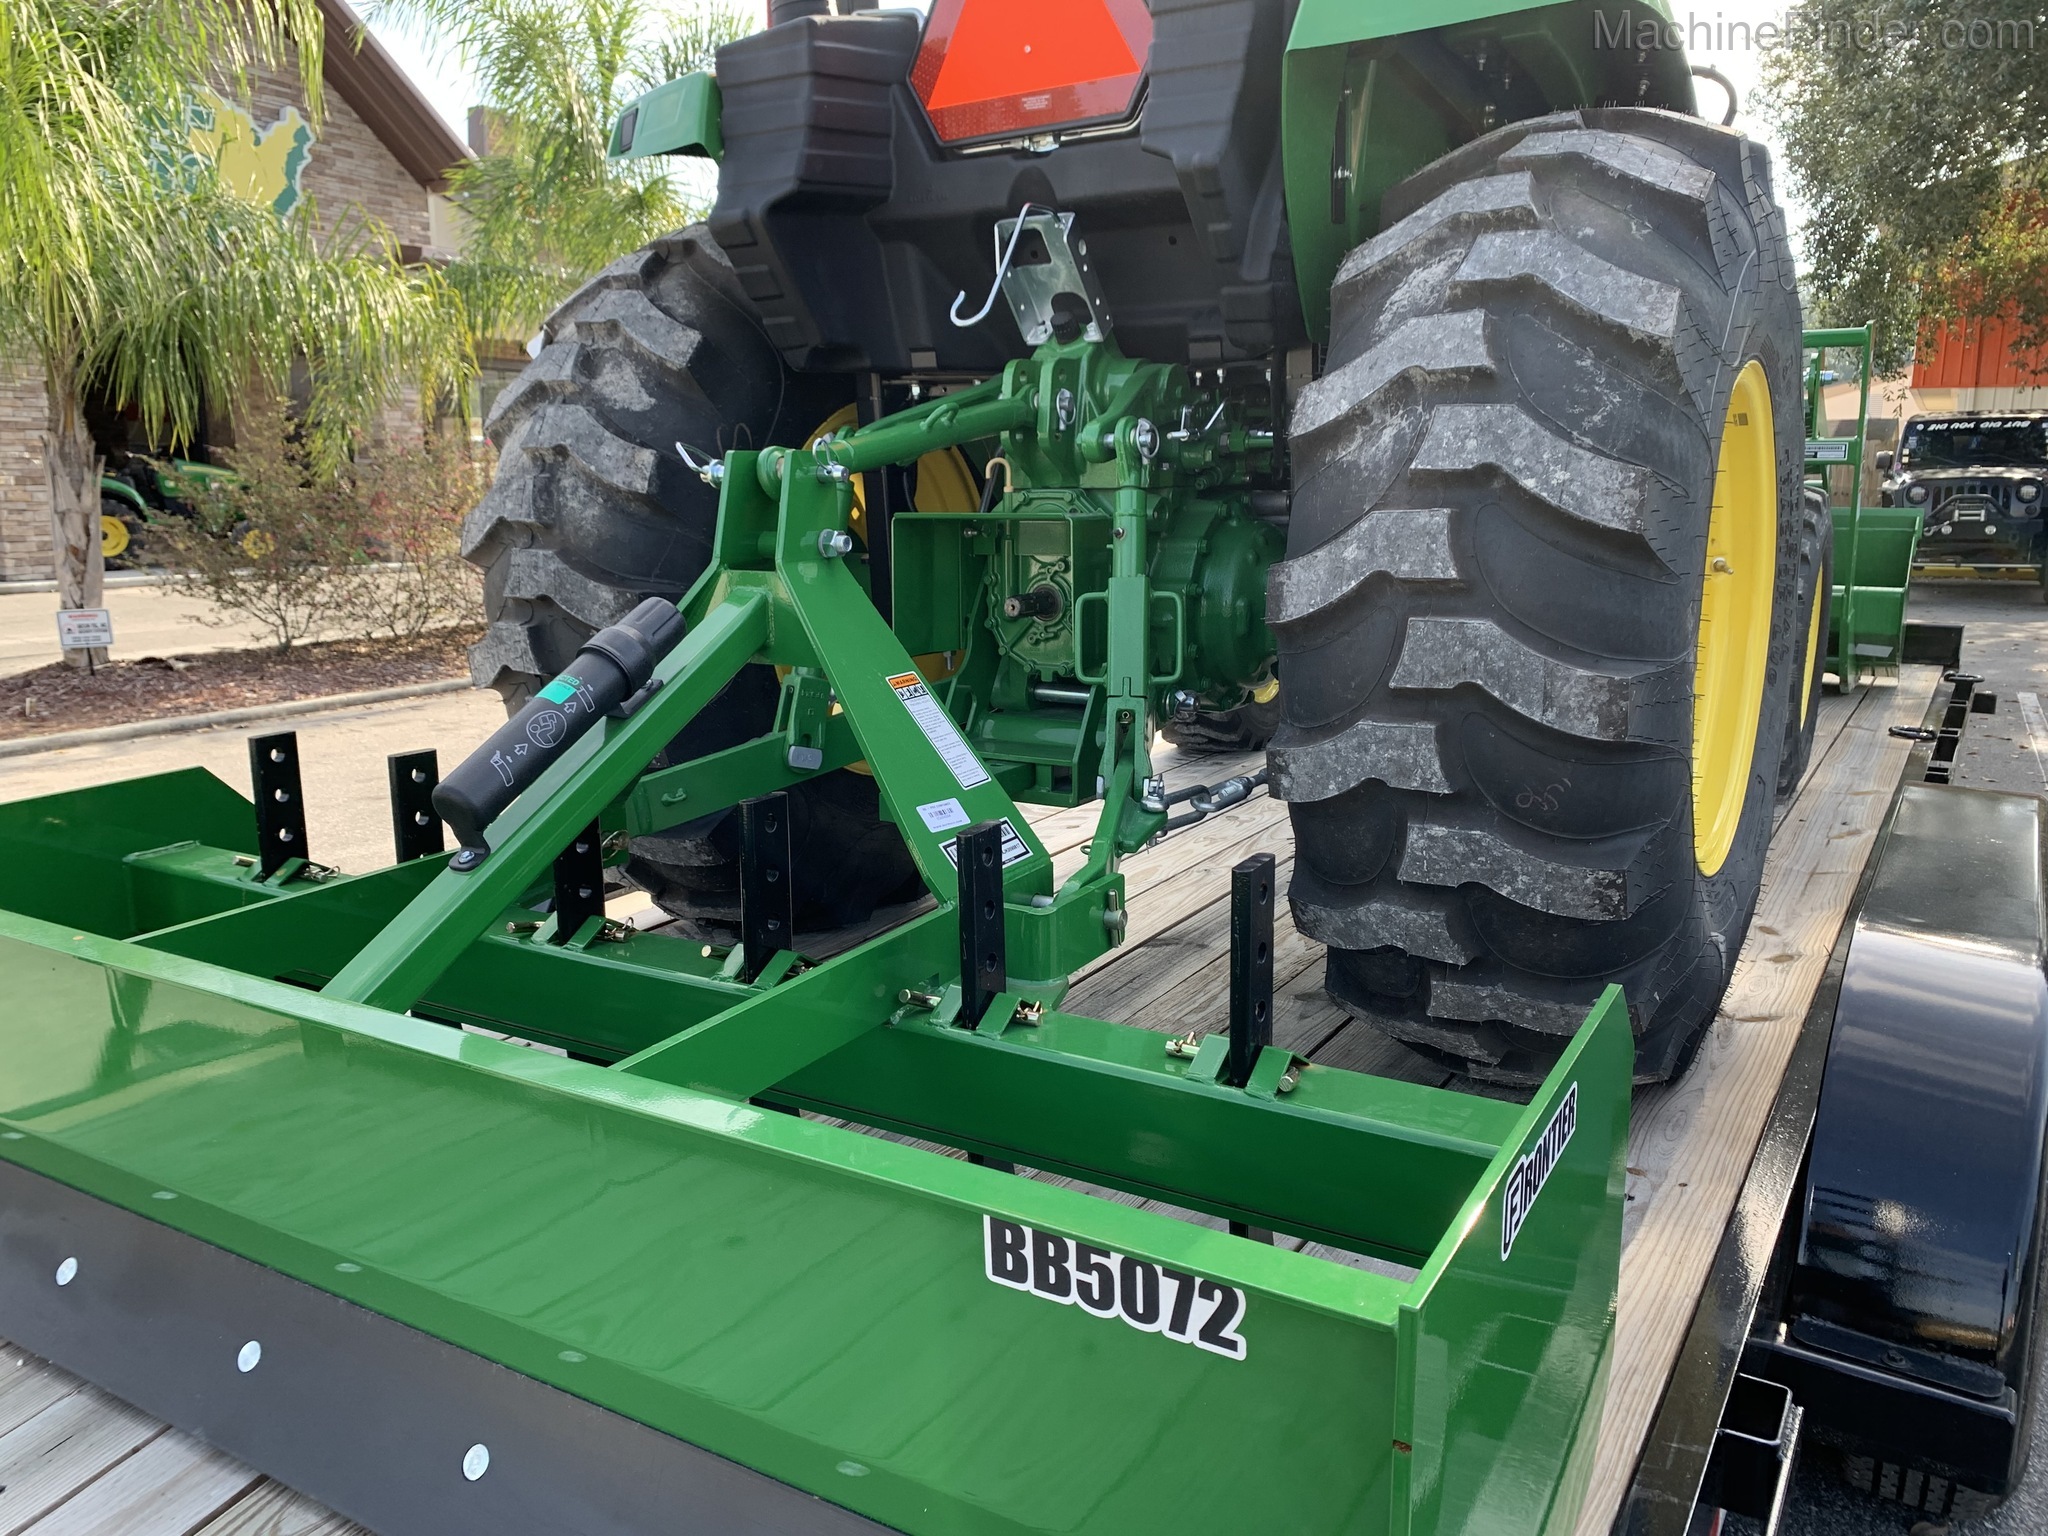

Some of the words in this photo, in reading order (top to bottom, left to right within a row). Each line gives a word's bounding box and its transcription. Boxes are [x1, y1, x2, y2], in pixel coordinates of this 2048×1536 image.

[1927, 423, 1949, 431] DIE
[1950, 421, 1976, 430] YOU
[1980, 421, 2002, 429] DID
[2003, 420, 2031, 428] BUT
[1502, 1083, 1577, 1258] FRONTIER
[986, 1215, 1242, 1356] BB5072
